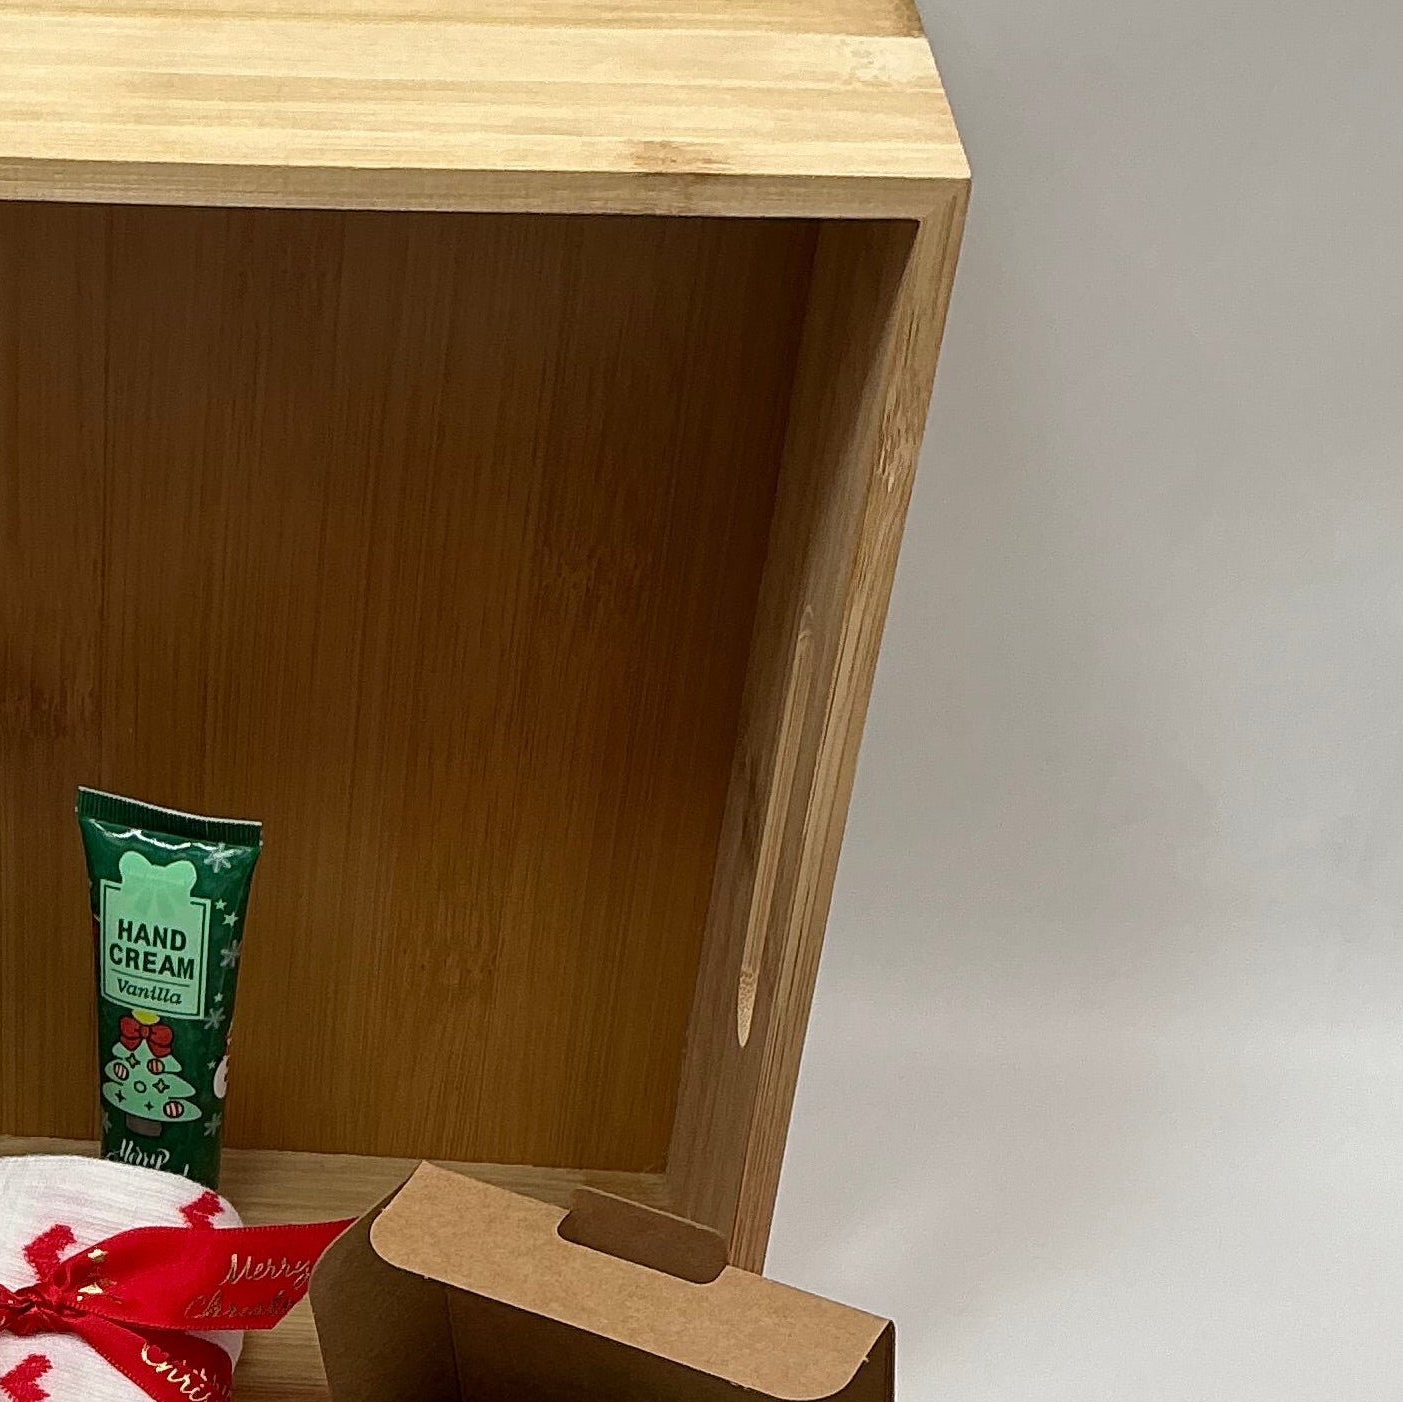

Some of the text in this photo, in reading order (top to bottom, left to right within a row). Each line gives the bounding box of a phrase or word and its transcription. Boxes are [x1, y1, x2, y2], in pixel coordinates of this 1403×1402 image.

[117, 918, 187, 953] HAND
[108, 942, 195, 981] CREAM
[116, 978, 183, 1005] Vanilla
[218, 1253, 311, 1290] Merry
